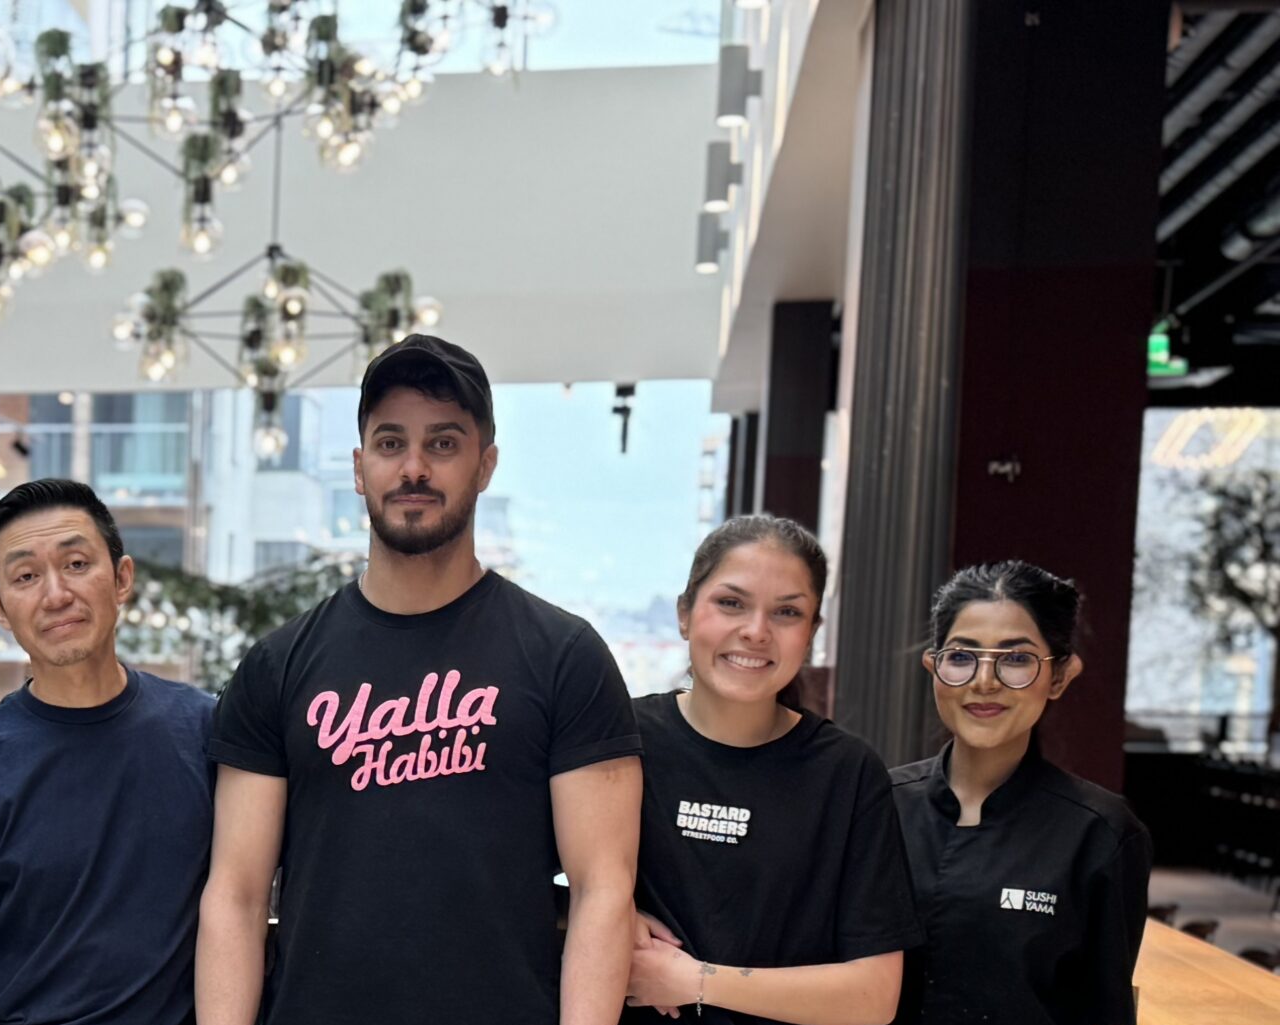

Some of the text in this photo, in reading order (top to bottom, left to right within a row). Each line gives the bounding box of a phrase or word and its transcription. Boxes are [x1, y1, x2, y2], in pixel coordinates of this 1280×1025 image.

[306, 669, 499, 766] Yalla
[350, 725, 487, 791] Habibi
[678, 800, 751, 822] BASTARD
[676, 814, 748, 837] BURGERS
[681, 829, 725, 842] STREETFOOD
[1025, 890, 1058, 905] SUSHI
[1025, 900, 1055, 916] YAMA
